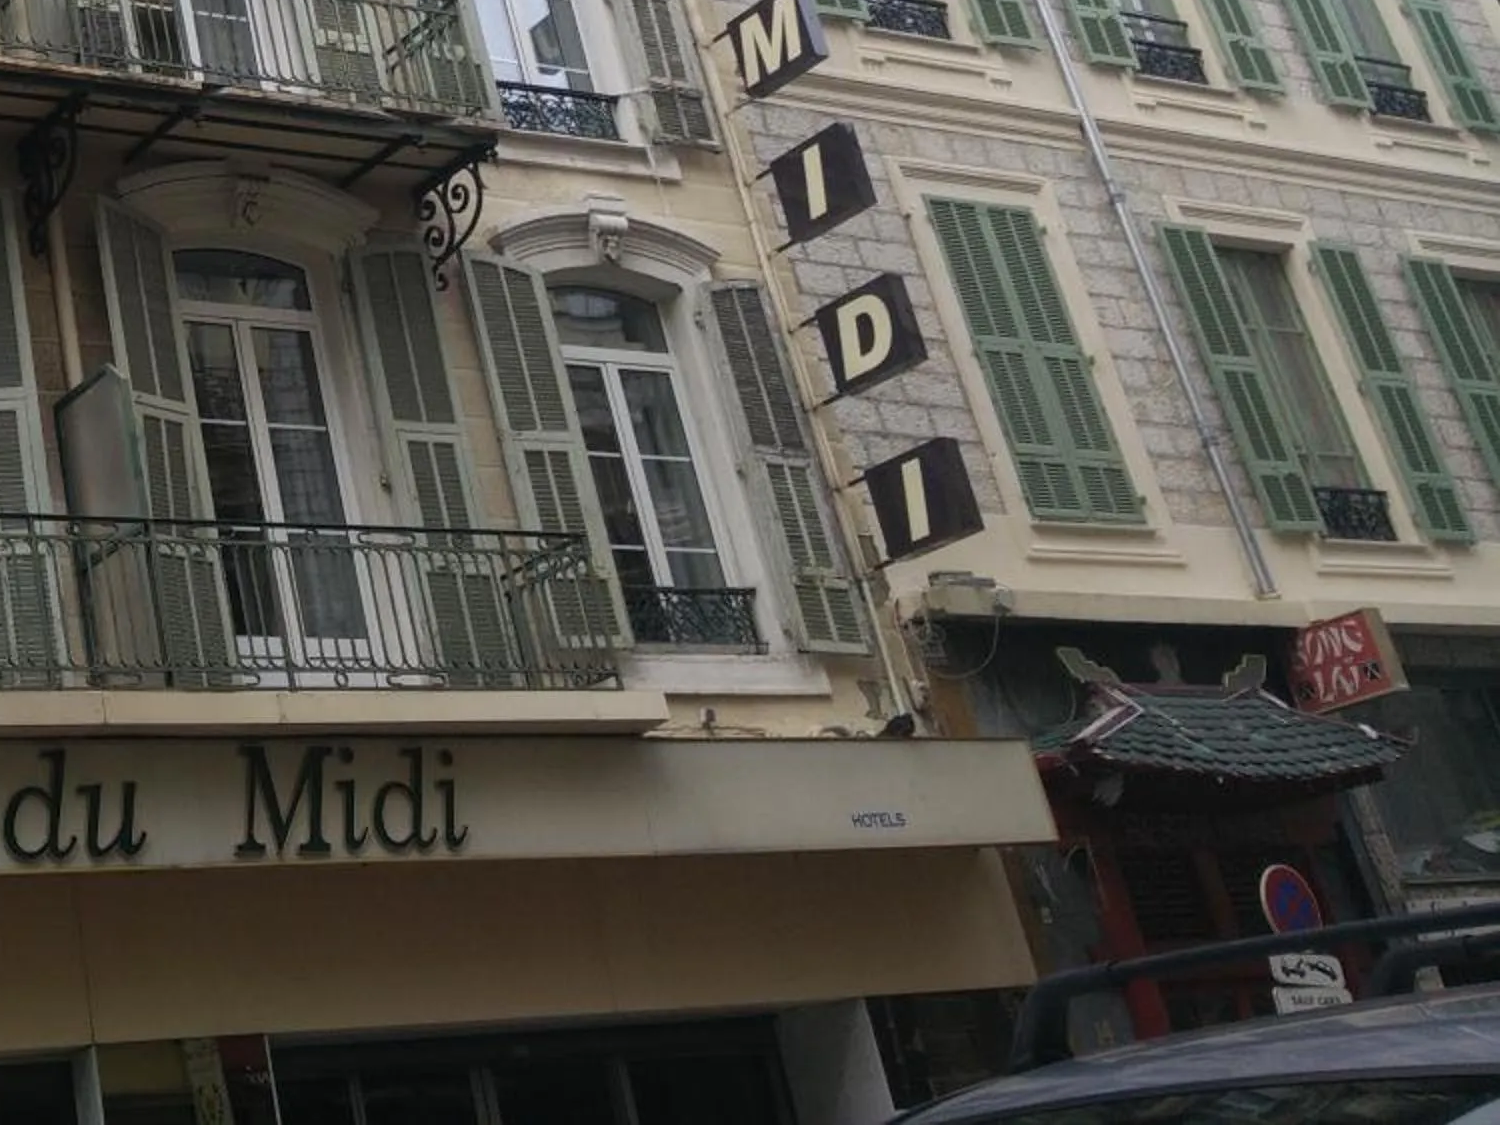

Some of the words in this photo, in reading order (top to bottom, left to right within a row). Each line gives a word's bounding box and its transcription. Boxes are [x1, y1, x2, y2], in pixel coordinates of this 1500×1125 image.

[1, 748, 148, 866] du
[235, 743, 470, 860] Midi
[851, 811, 907, 828] HOTELS
